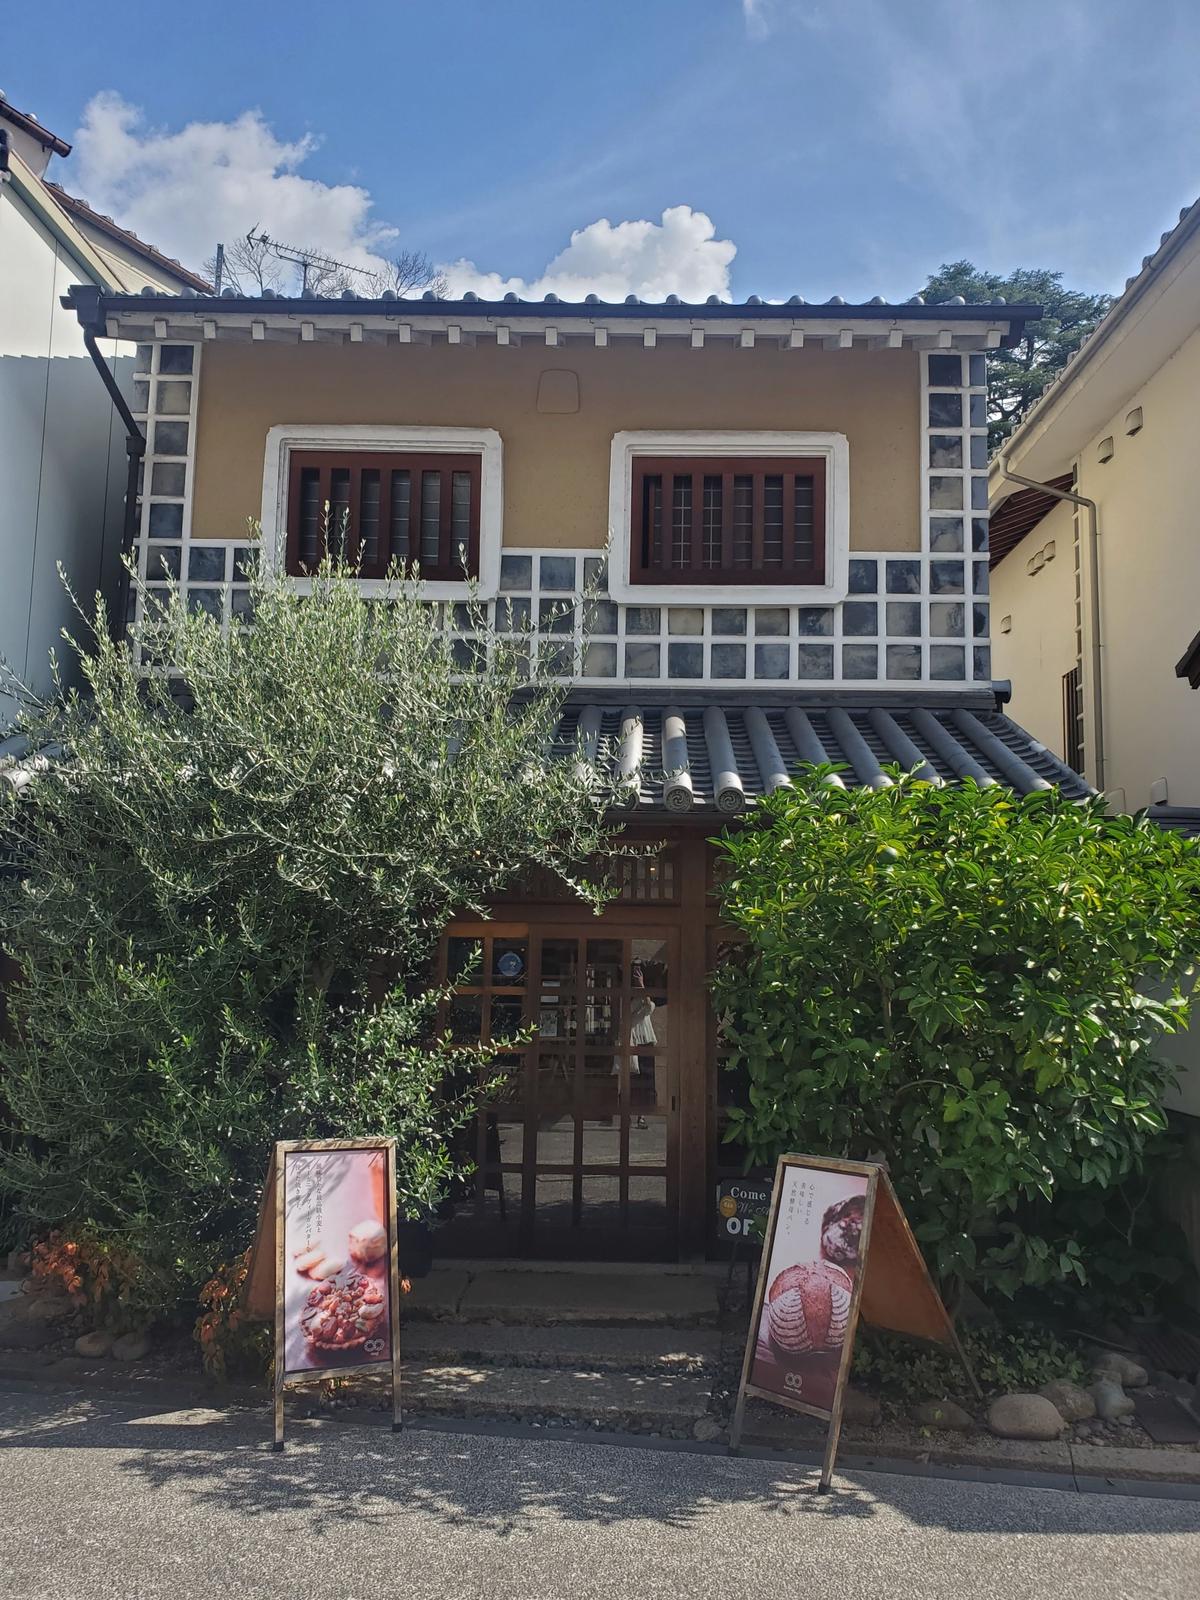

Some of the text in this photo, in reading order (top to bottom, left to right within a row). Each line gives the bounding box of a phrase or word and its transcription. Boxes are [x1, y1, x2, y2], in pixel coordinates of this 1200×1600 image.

[730, 1186, 767, 1201] Come
[796, 1181, 807, 1215] 美味しい
[804, 1183, 816, 1225] 心で感じる
[726, 1217, 756, 1236] OP
